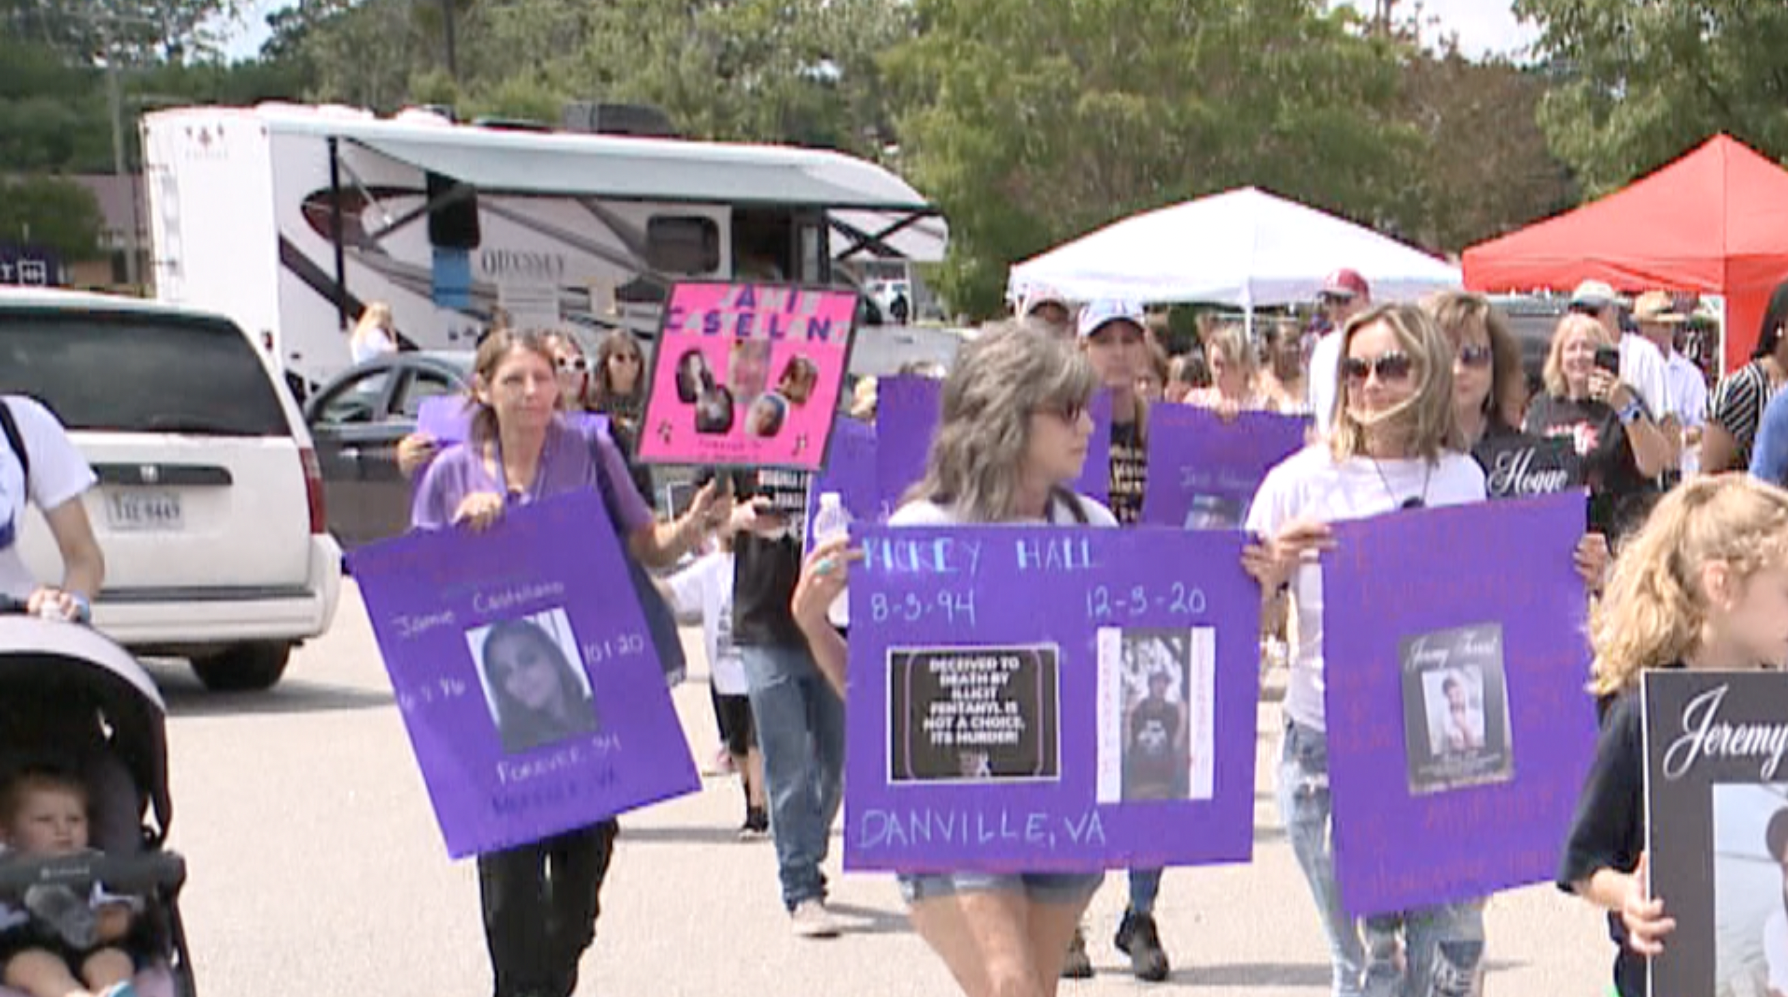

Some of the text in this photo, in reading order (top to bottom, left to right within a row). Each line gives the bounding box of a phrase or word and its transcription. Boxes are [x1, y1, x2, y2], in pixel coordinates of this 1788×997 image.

[1016, 536, 1103, 570] HALL
[1086, 581, 1207, 617] 12-3-20
[929, 656, 1020, 672] DECEIVED TO
[939, 671, 1010, 687] DEATH BY
[951, 686, 998, 700] ILLICIT
[929, 700, 1018, 715] FENTANYL IS
[923, 717, 954, 732] NOT
[957, 717, 968, 730] A
[930, 731, 1019, 745] ITS MURDER!
